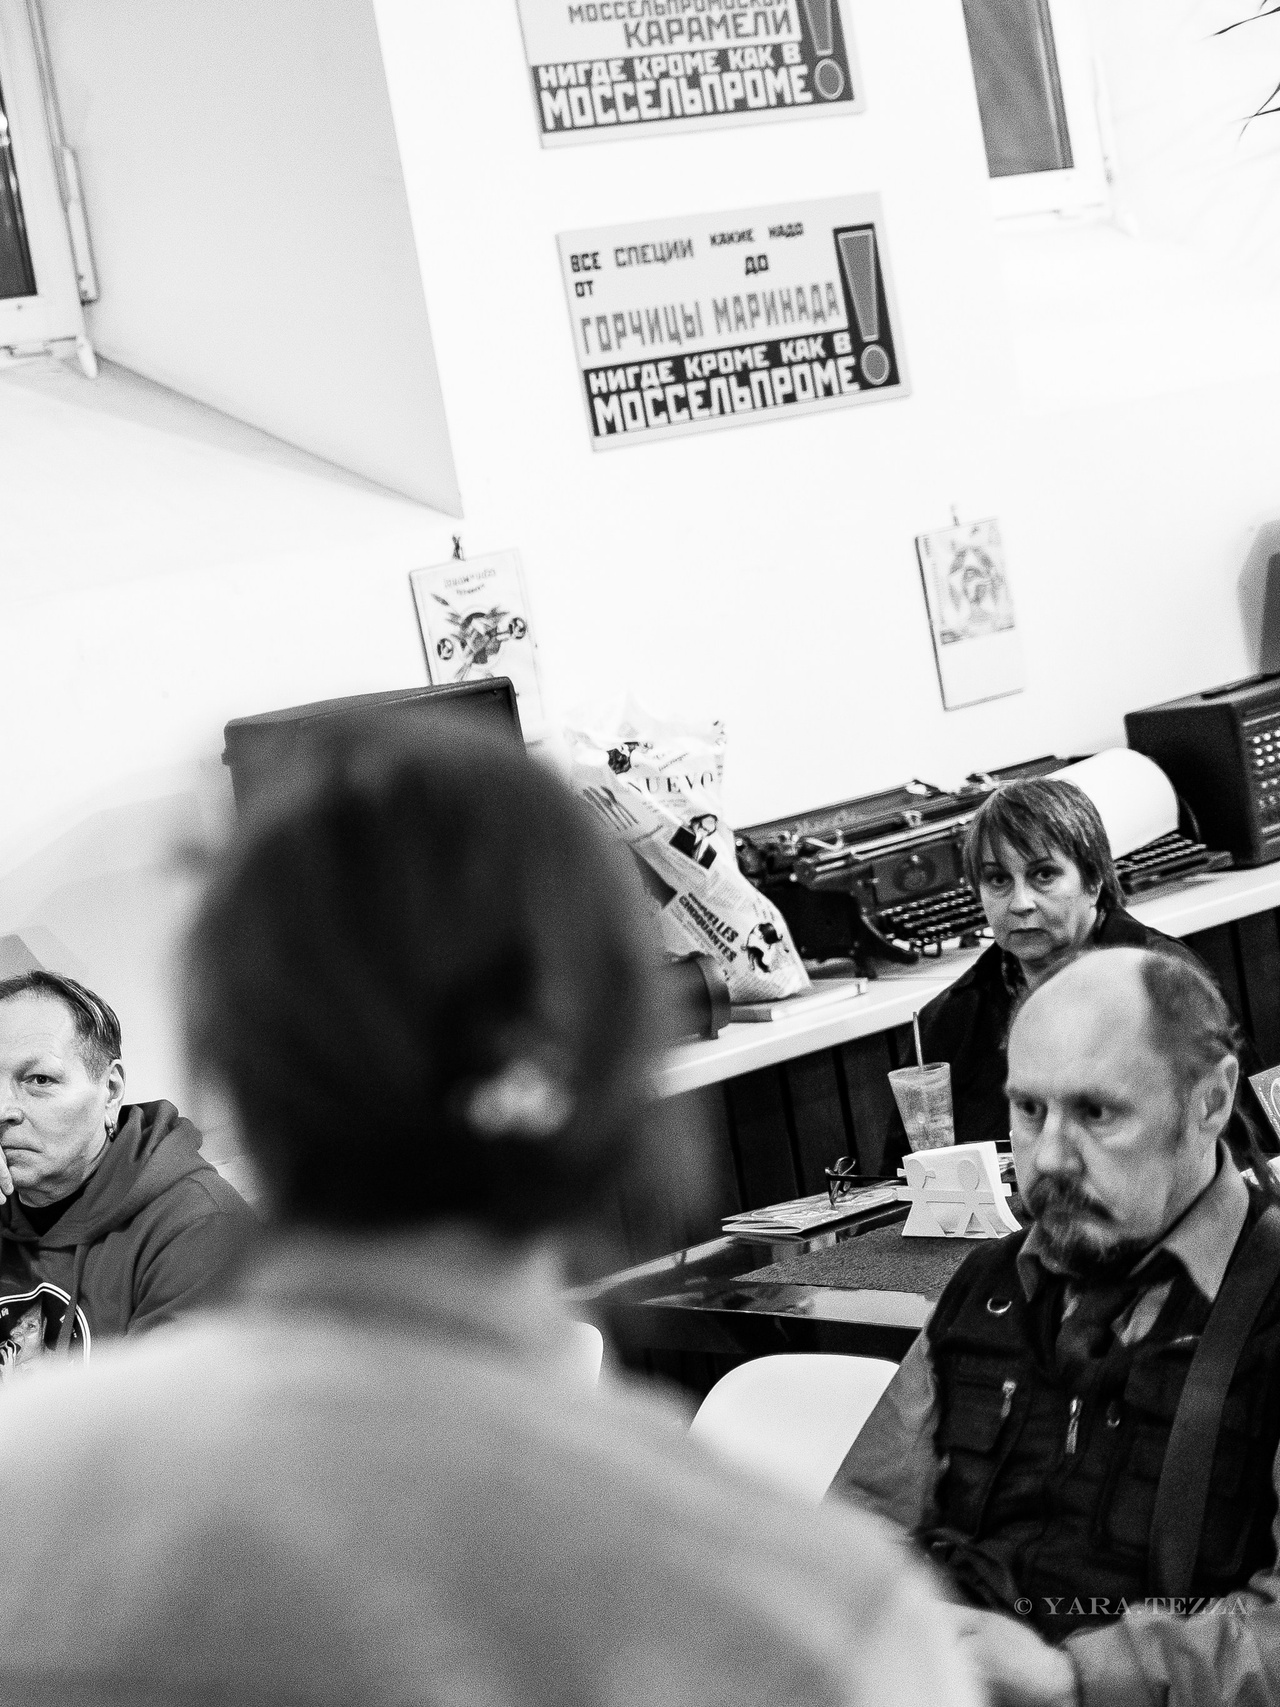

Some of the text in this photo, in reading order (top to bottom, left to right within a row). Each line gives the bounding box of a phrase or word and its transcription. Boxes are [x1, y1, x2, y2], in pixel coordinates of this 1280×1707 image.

[624, 9, 793, 48] КАРАМЕЛИ
[539, 42, 801, 89] НИГДЕ КРОМЕ КАК В
[540, 65, 813, 130] МОССЕЛЬПРОМЕ
[570, 221, 804, 272] ВСЕ СПЕЦИИ КАКИЕ НАДО
[575, 254, 769, 297] ОТ ДО
[580, 281, 840, 356] ГОРЧИЦЫ МАРИНАДА
[588, 331, 852, 395] НИГДЕ КРОМЕ КАК В
[593, 356, 861, 436] МОССЕЛЬПРОМЕ
